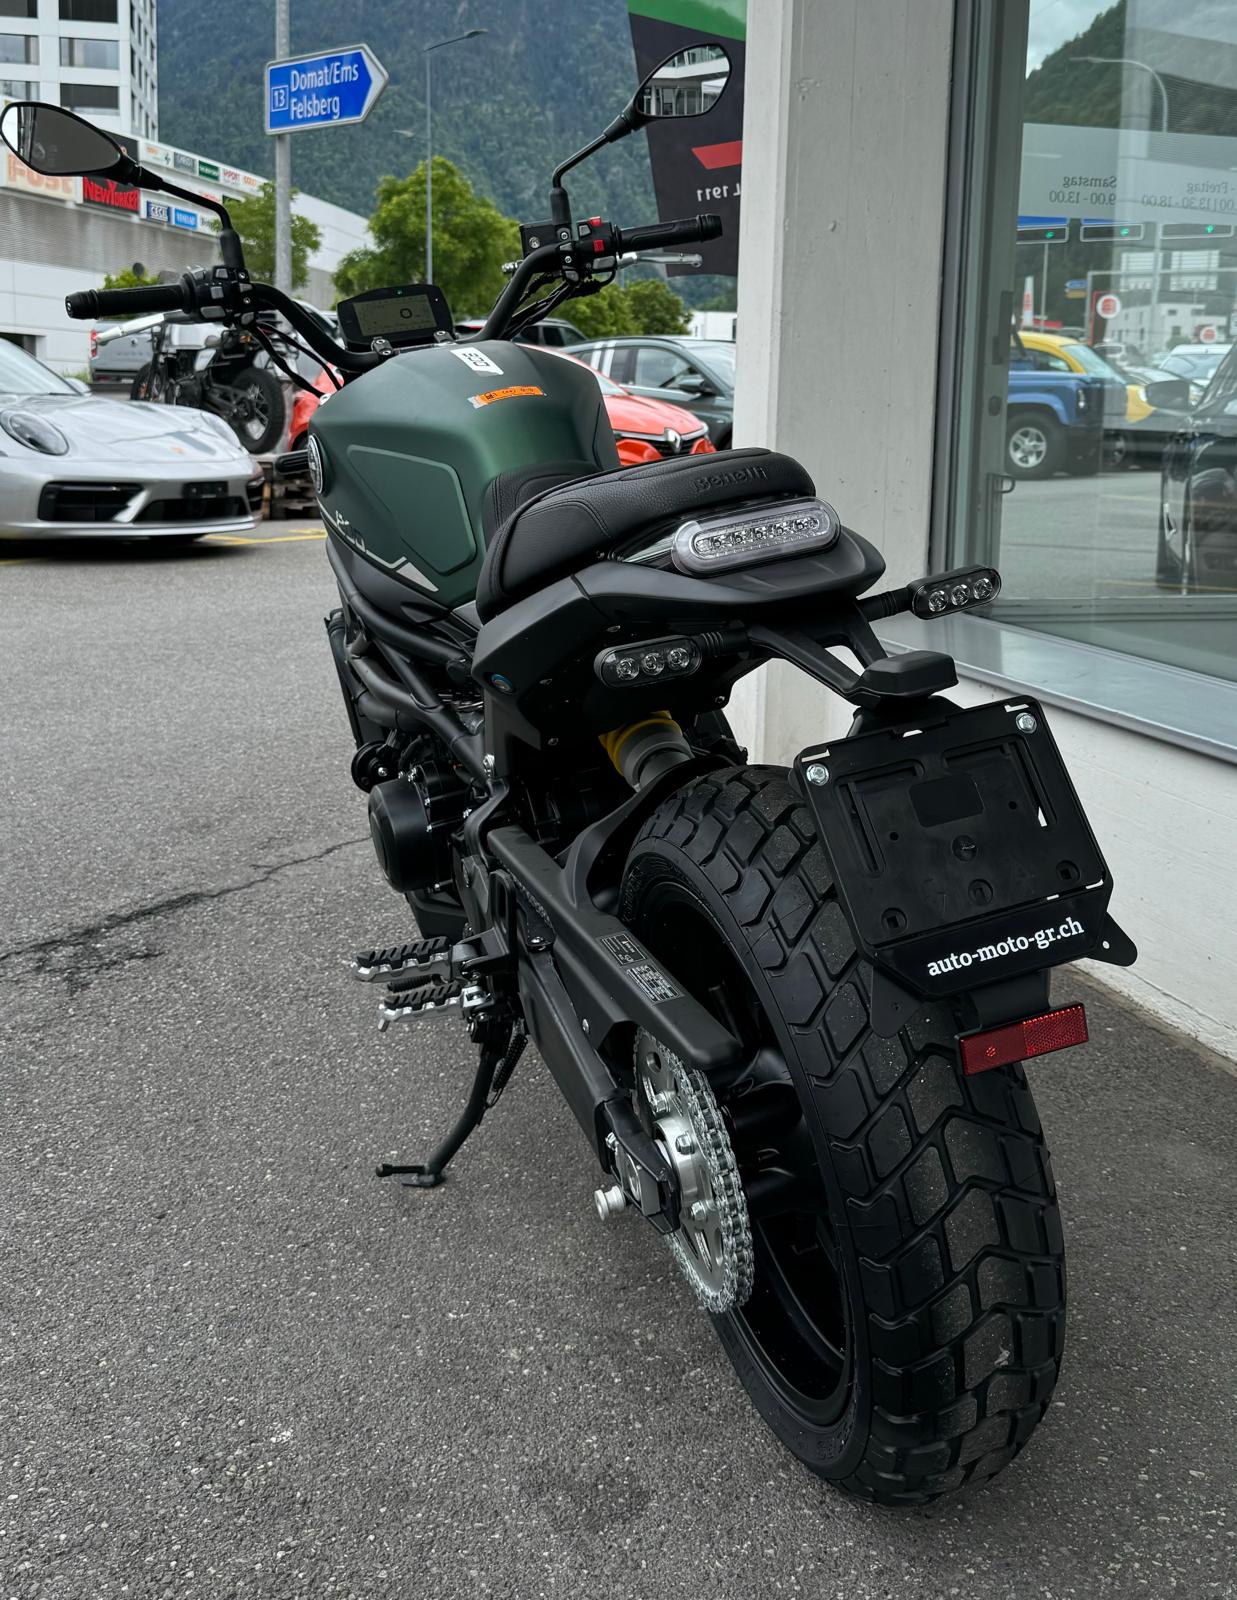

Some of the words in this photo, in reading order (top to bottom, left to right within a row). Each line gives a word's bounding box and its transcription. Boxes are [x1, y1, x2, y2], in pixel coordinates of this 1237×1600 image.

[290, 62, 359, 92] Domat/Ems
[273, 89, 286, 108] 13
[290, 93, 341, 120] Felsberg
[688, 467, 767, 494] Benelli
[927, 916, 1085, 977] auto-moto-gr.ch
